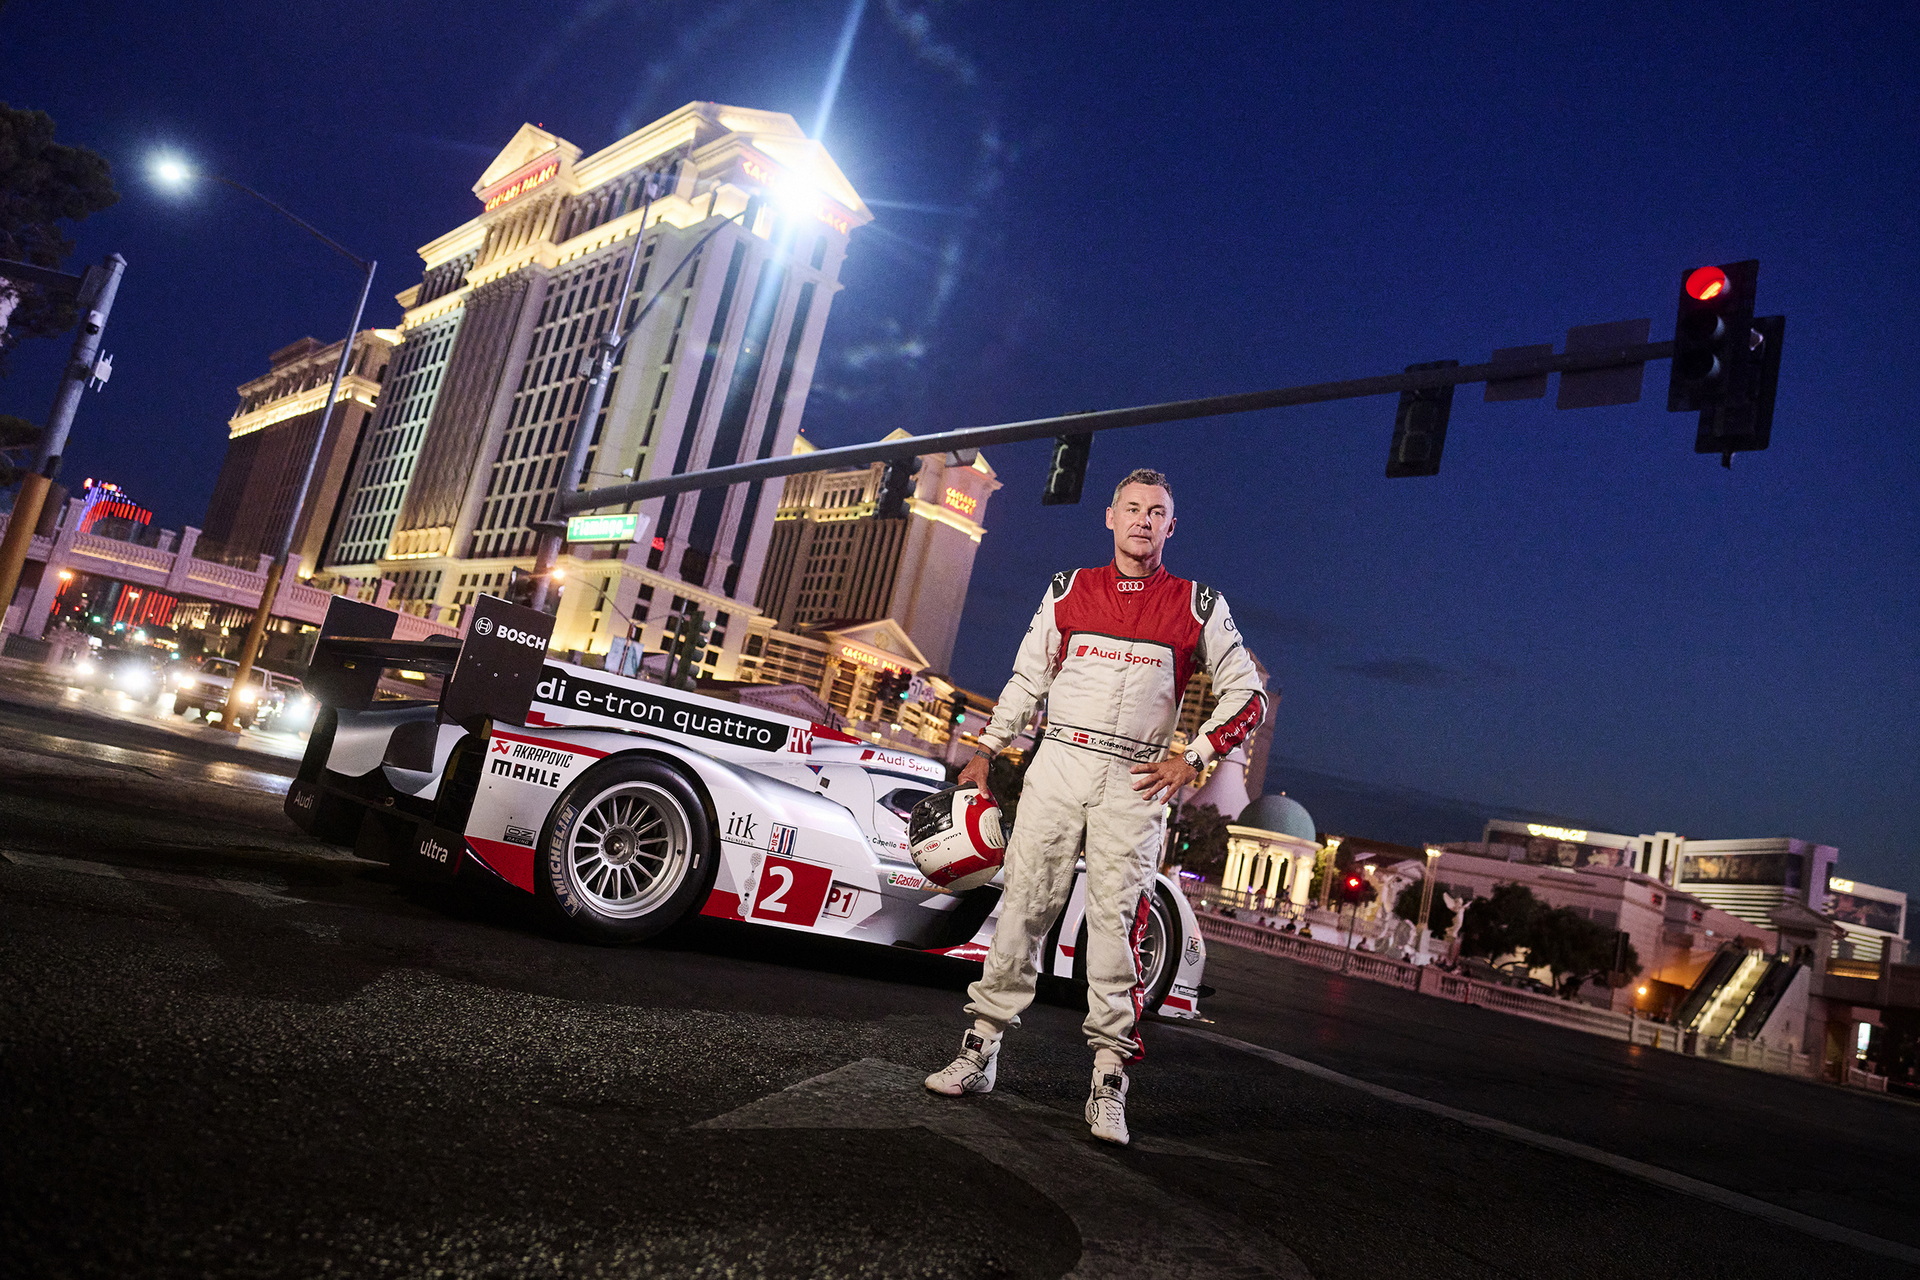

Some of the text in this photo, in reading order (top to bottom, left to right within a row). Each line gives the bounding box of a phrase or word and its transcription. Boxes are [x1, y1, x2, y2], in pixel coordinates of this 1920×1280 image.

[573, 518, 624, 538] Flamingo
[496, 624, 547, 651] BOSCH
[841, 646, 879, 667] CAESARS
[1089, 646, 1163, 668] Audi Sport
[536, 677, 772, 744] di e-tron quattro
[789, 727, 813, 754] HY
[1090, 737, 1097, 745] T.
[1224, 726, 1241, 740] Audi
[490, 758, 561, 788] MAHLE
[877, 752, 940, 775] Audi Sport
[293, 790, 315, 810] Audi
[725, 811, 758, 841] itk
[420, 838, 448, 863] ultra
[506, 836, 530, 845] RACING
[550, 806, 575, 896] MICHELIN
[770, 826, 780, 852] IMSA
[872, 837, 897, 849] Capello
[758, 865, 794, 913] 2
[895, 873, 923, 888] Castrol
[824, 888, 853, 913] P1
